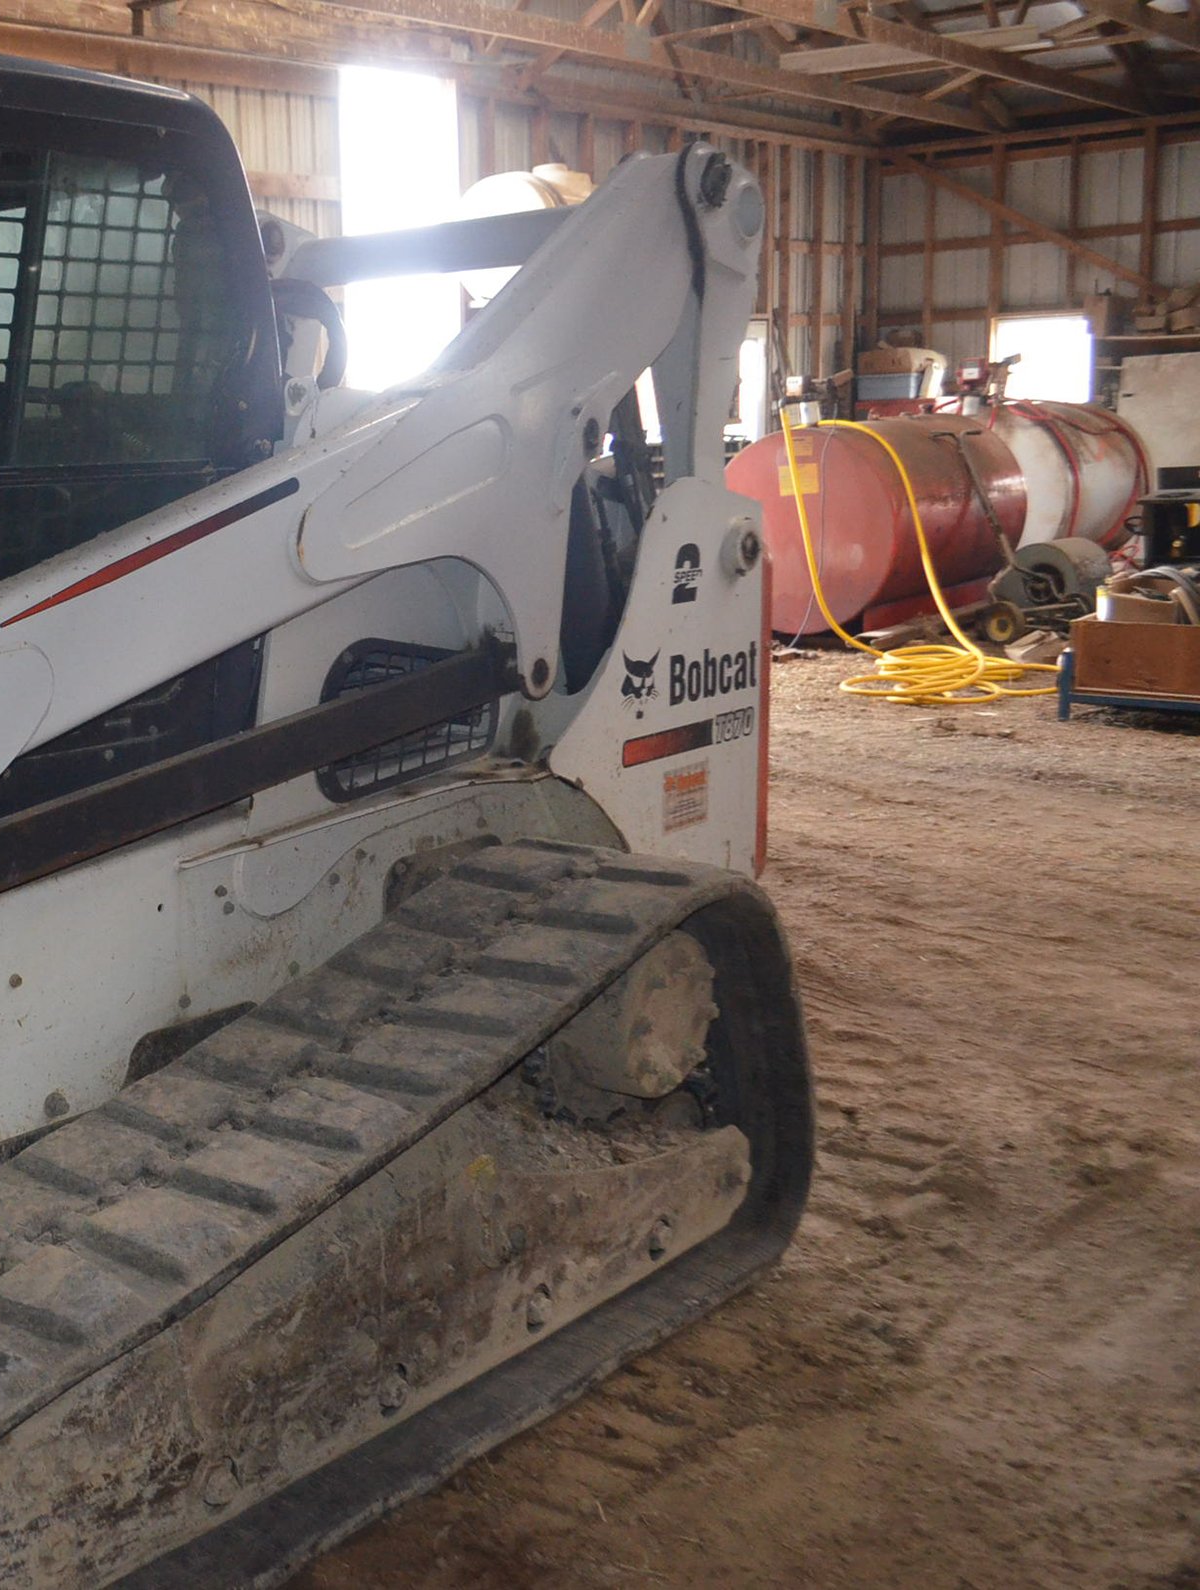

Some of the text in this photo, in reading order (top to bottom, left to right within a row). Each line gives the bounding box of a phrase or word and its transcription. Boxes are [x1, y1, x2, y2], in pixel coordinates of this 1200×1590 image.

[672, 543, 700, 605] 2
[669, 641, 757, 706] Bobcat
[715, 706, 754, 744] T870
